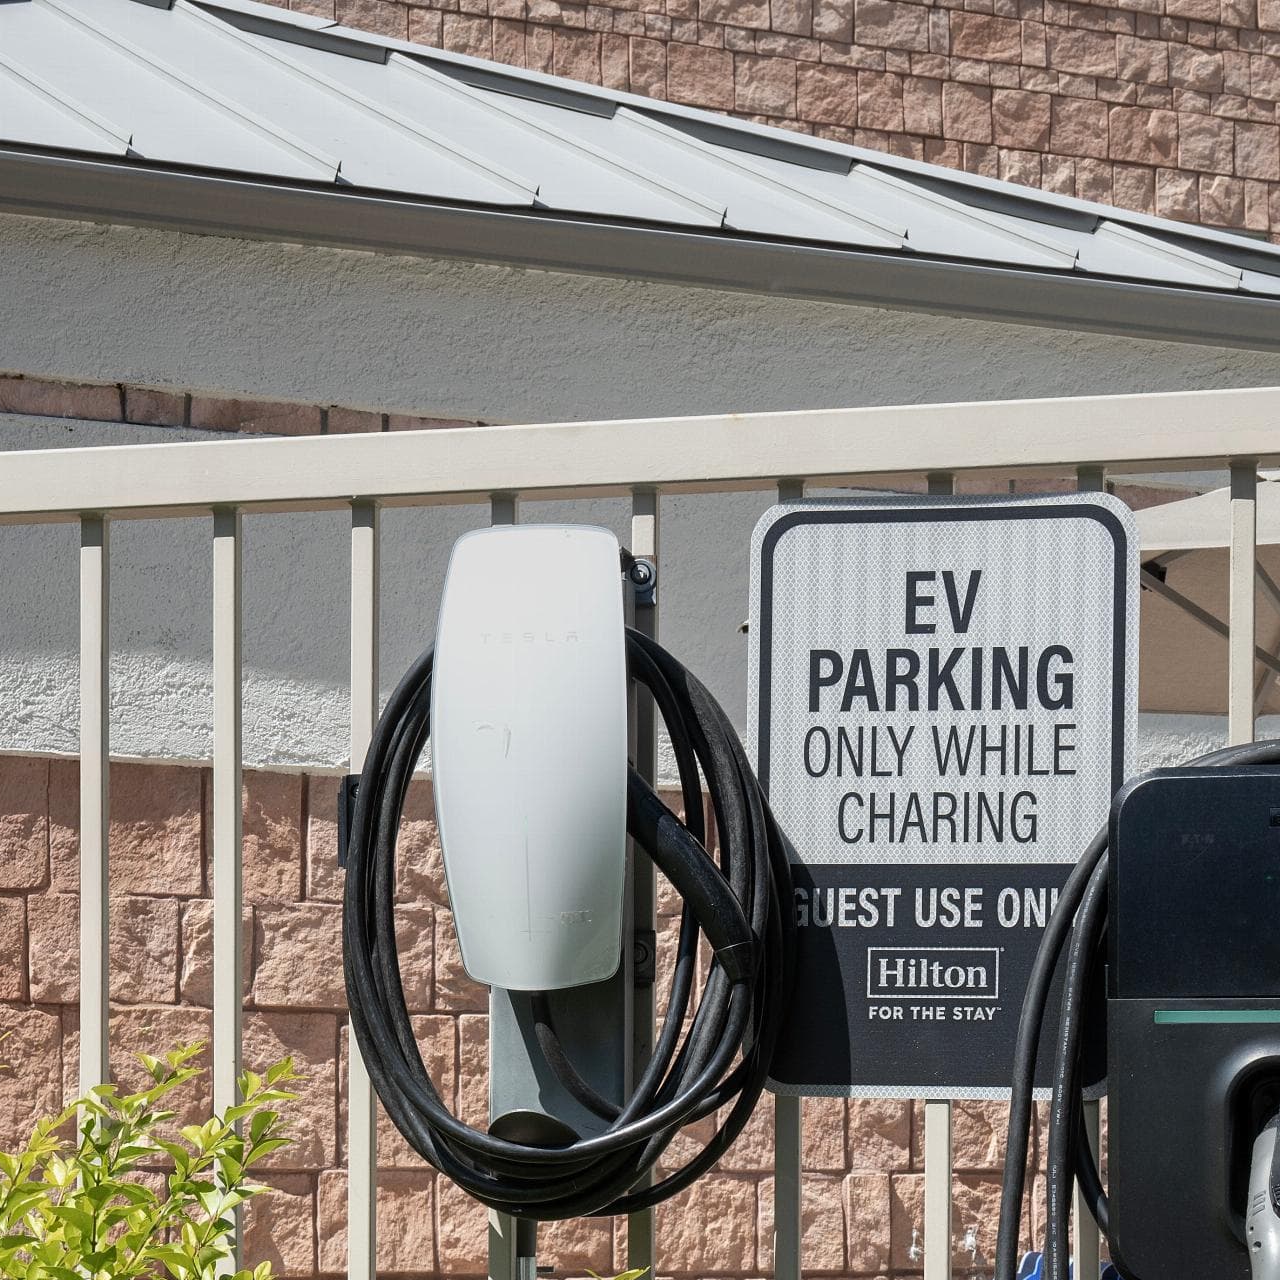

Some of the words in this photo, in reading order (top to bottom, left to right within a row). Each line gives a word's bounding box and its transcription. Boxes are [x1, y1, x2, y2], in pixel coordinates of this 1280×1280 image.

[905, 569, 982, 635] EV
[480, 631, 579, 645] TESLA
[809, 645, 1075, 713] PARKING
[804, 725, 915, 778] ONLY
[932, 724, 1077, 777] WHILE
[837, 790, 1039, 845] CHARING
[793, 887, 902, 928] GUEST
[915, 887, 983, 928] USE
[997, 887, 1077, 928] ON
[878, 958, 988, 988] Hilton
[868, 1006, 904, 1020] FOR
[910, 1006, 946, 1020] THE
